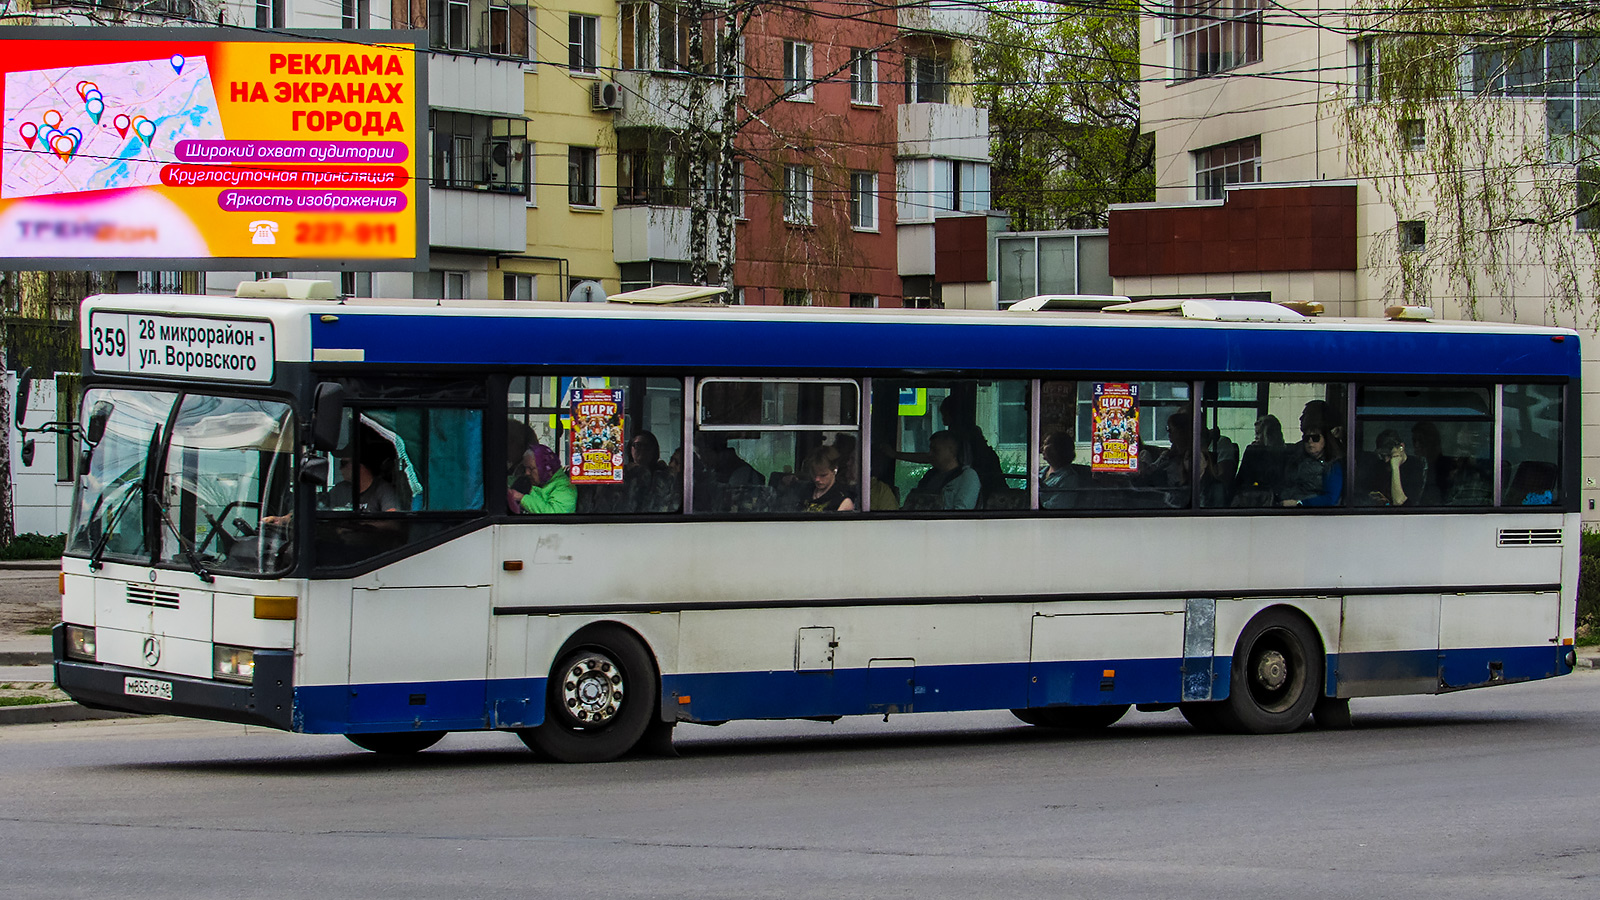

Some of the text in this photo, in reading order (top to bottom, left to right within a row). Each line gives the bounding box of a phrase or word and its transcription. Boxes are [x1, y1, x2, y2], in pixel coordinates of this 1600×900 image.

[270, 53, 404, 75] РЕКЛАМА
[230, 81, 404, 104] НА ЭКРАНАХ
[292, 110, 405, 136] ГОРОДА
[185, 144, 395, 161] Широкий охват аудитории
[169, 168, 395, 186] Круглосуточная трансляция
[226, 193, 397, 208] Яркость изображения
[93, 326, 126, 357] 359
[139, 319, 156, 340] 28
[160, 324, 254, 348] микрорайон
[139, 345, 257, 372] ул. Воровского
[574, 390, 580, 398] 5
[1096, 384, 1102, 393] 5
[581, 405, 614, 415] ЦИРК
[1102, 398, 1131, 408] ЦИРК
